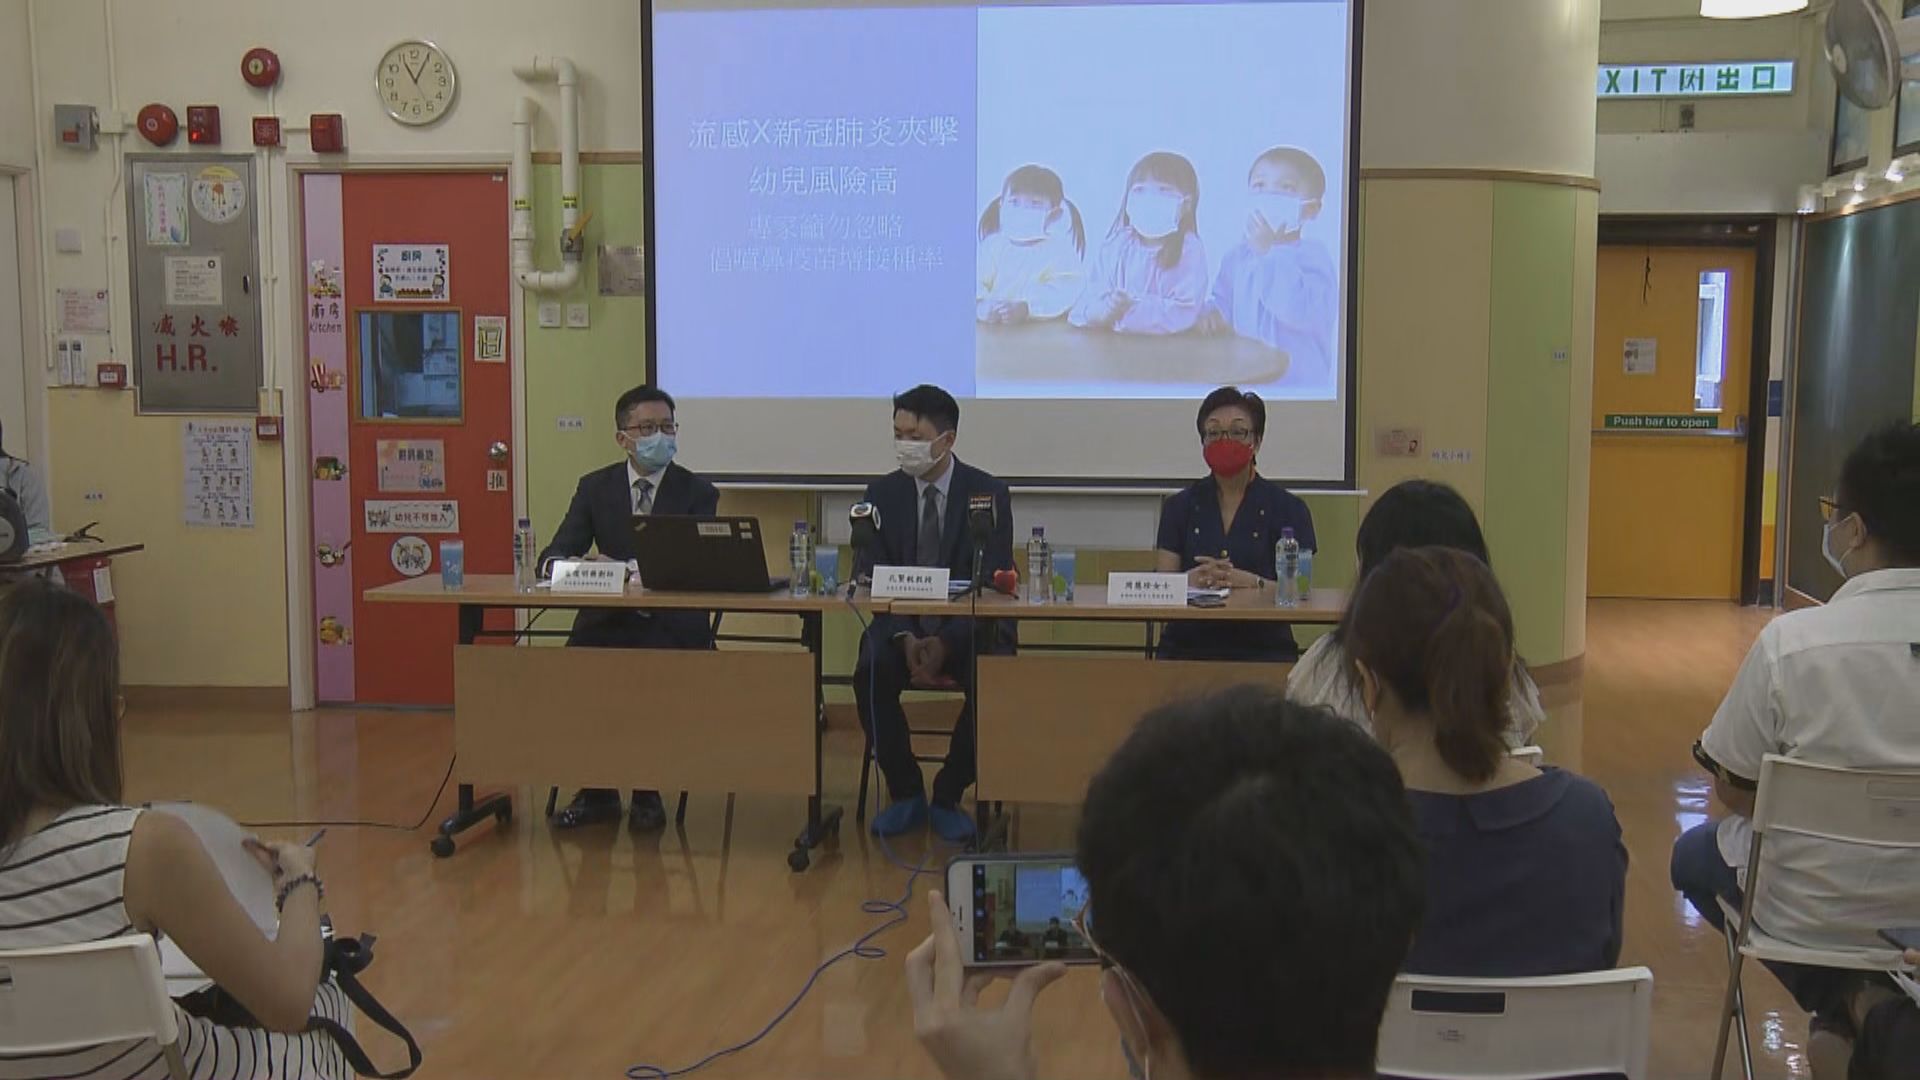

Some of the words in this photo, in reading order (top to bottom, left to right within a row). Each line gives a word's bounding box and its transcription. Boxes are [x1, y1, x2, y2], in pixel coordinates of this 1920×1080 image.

[1716, 66, 1775, 91] 出口
[688, 115, 960, 149] 流感X新冠肺炎夾擊
[748, 165, 898, 196] 幼兒風險高
[309, 321, 342, 334] Kitchen
[156, 343, 218, 372] H.R.
[1613, 415, 1642, 426] Push
[1645, 416, 1664, 426] bar
[1666, 416, 1678, 427] to
[1681, 418, 1710, 429] open
[488, 471, 505, 489] 推
